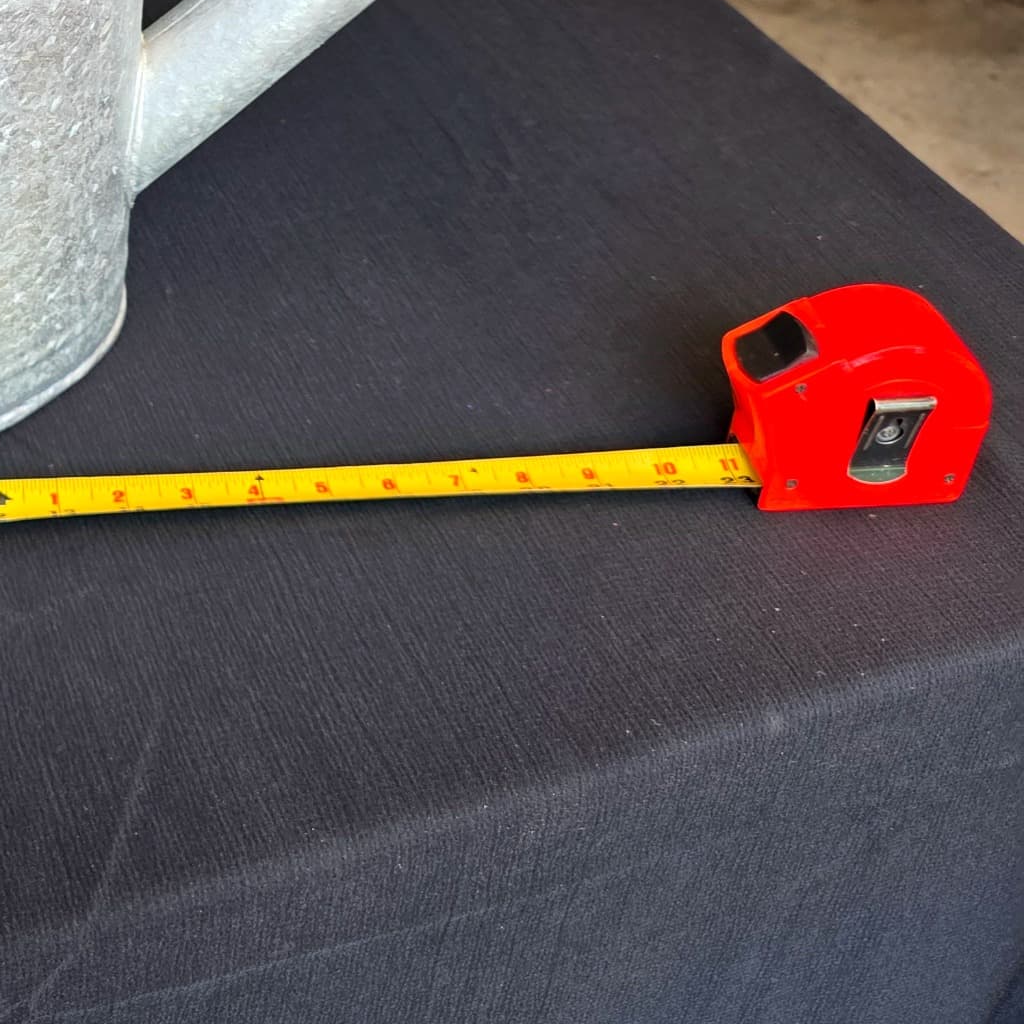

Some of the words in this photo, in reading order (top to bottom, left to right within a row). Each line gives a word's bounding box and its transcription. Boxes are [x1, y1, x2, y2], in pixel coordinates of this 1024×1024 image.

[50, 492, 59, 505] 1
[112, 490, 125, 502] 2
[180, 488, 193, 499] 3
[248, 485, 260, 495] 4
[315, 482, 328, 493] 5
[382, 478, 396, 489] 6
[448, 475, 459, 486] 7
[516, 471, 529, 483] 8
[581, 468, 594, 479] 9
[653, 462, 677, 475] 10
[719, 458, 739, 471] 11
